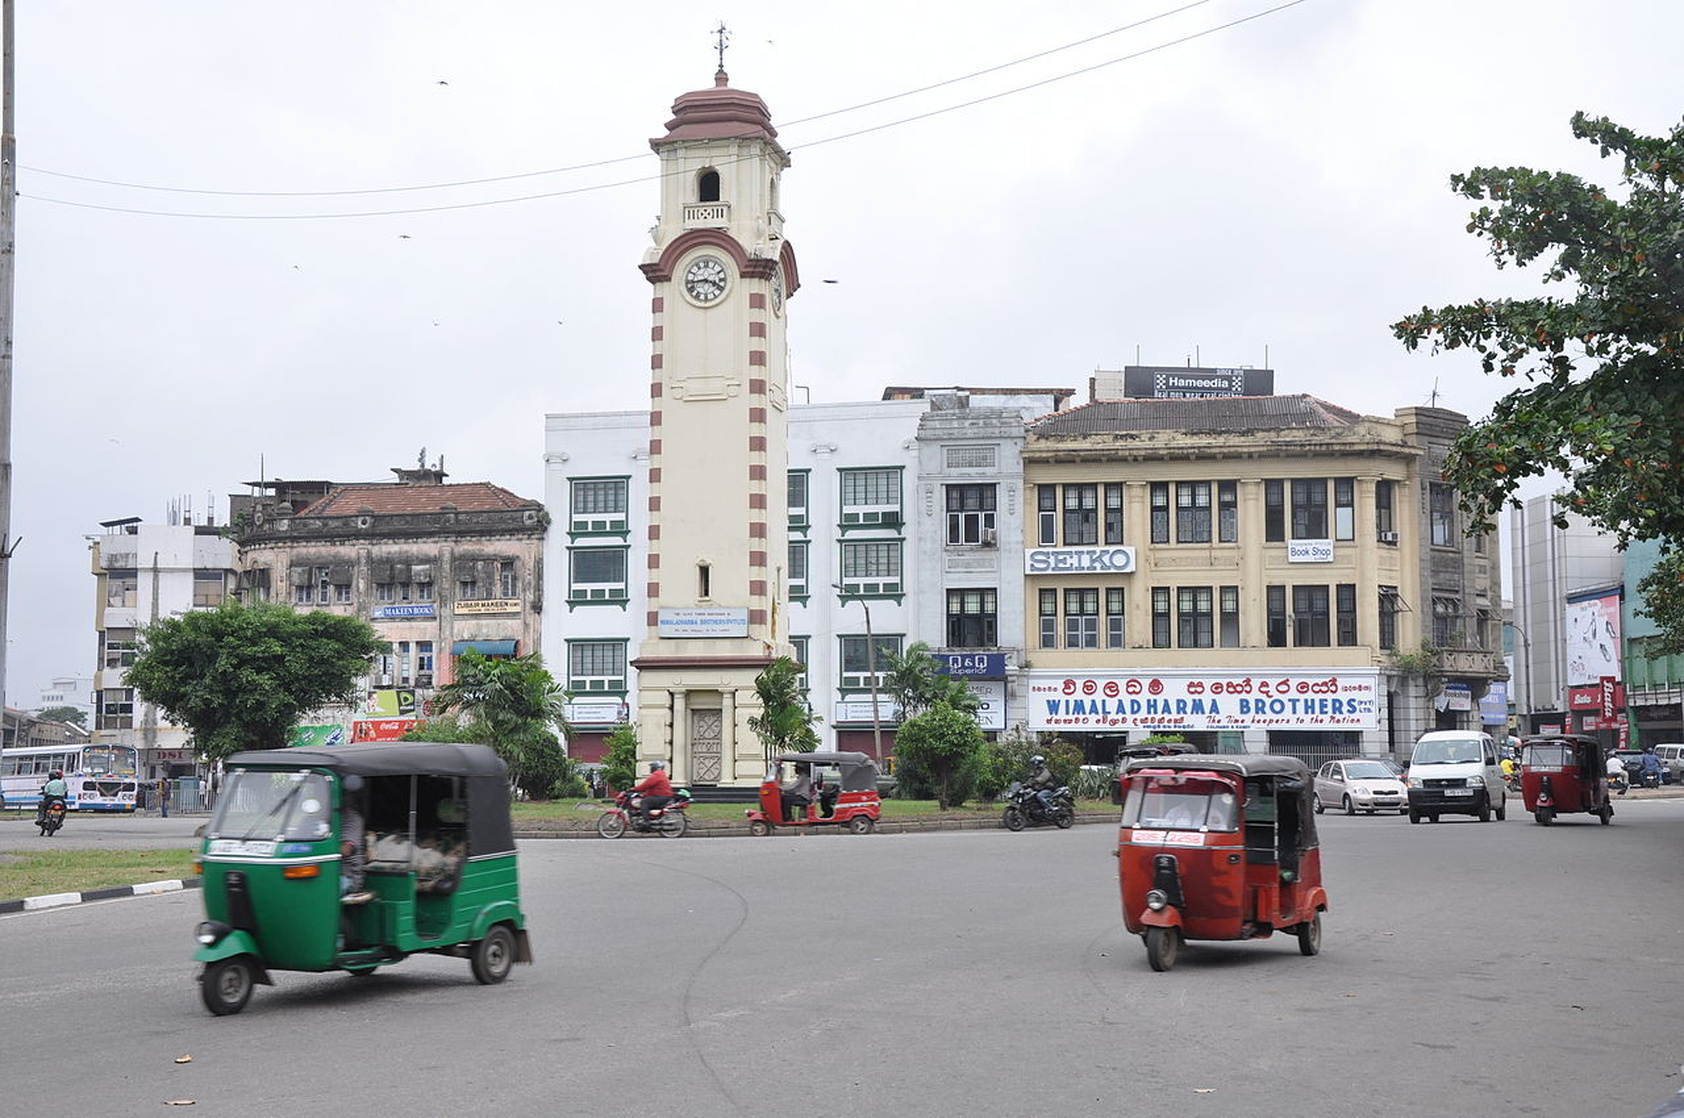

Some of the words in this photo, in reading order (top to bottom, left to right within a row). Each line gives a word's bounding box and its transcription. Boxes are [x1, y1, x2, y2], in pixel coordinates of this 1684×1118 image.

[1168, 376, 1229, 388] Hameedia
[1290, 546, 1311, 556] Book
[1312, 546, 1331, 560] Shop
[1029, 549, 1131, 572] SEIKO
[949, 667, 988, 676] Superior
[1602, 679, 1615, 718] Bata
[1046, 698, 1220, 716] WIMALADHARMA
[1239, 698, 1358, 715] BROTHERS
[1206, 715, 1222, 725] The
[1225, 715, 1246, 725] Time
[1251, 715, 1291, 726] keepers
[1295, 715, 1305, 724] to
[1309, 715, 1324, 724] the
[1328, 715, 1361, 725] Nation
[157, 750, 183, 760] DSI
